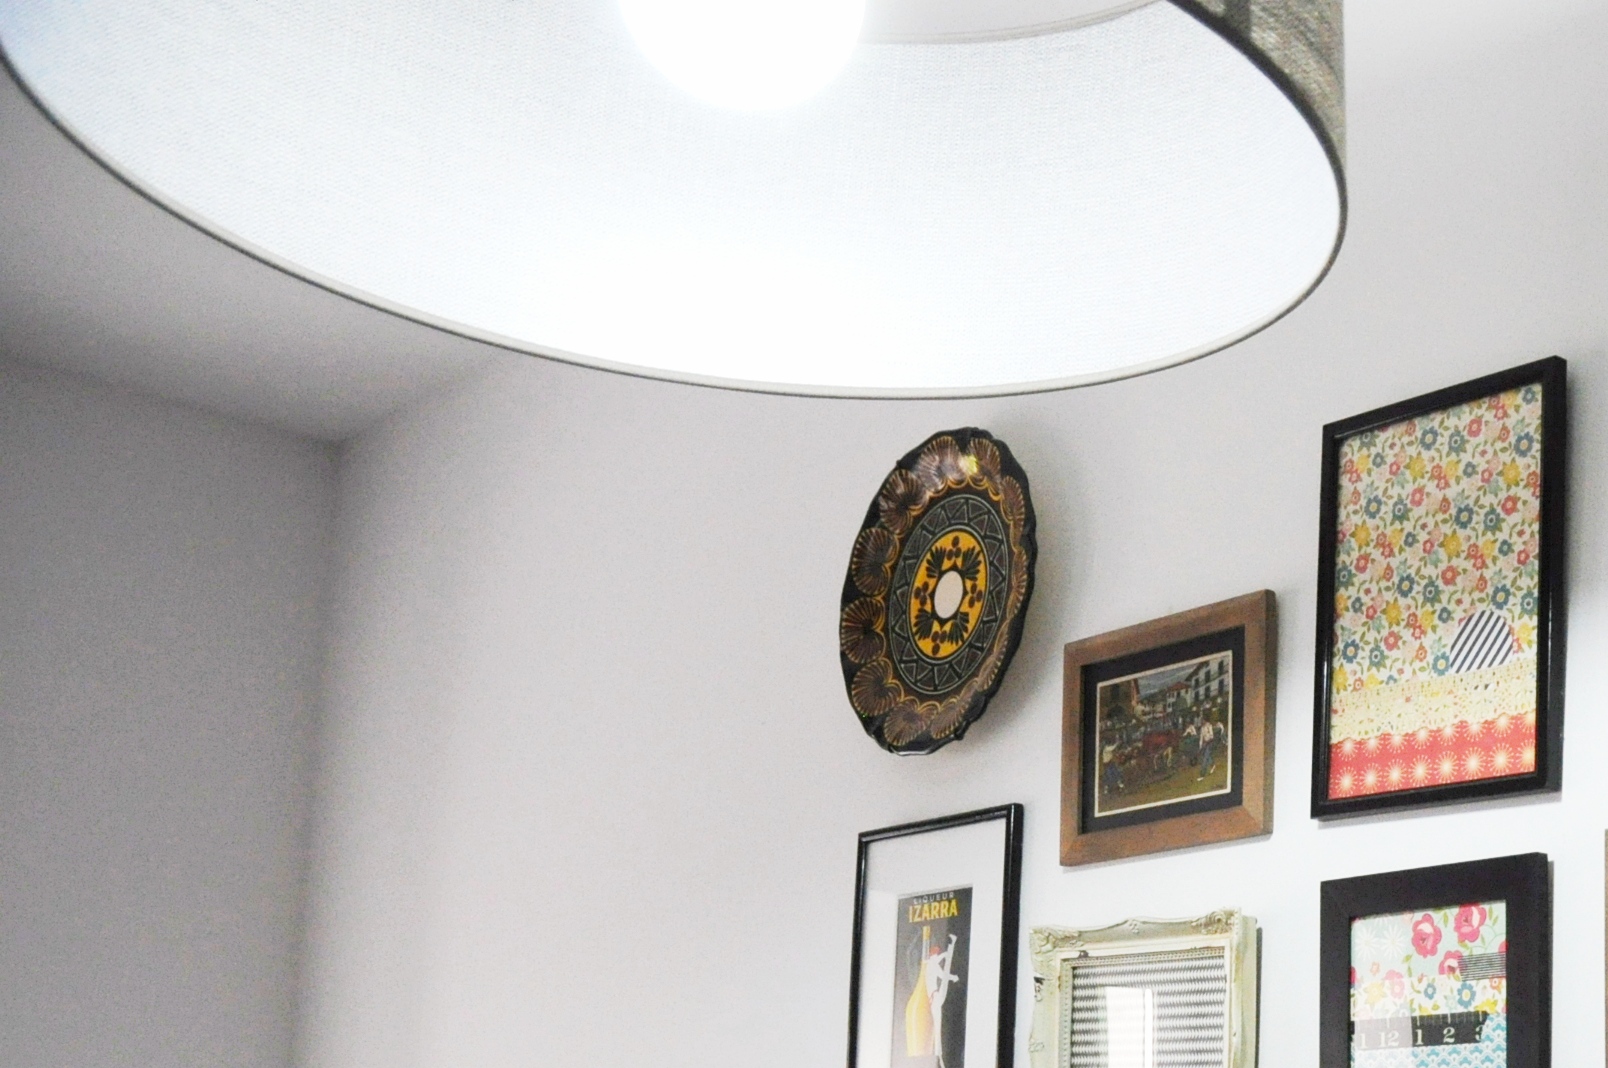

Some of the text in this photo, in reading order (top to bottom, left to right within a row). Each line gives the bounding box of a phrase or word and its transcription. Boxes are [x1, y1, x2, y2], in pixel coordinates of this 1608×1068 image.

[913, 891, 955, 905] LIQUEUR
[909, 899, 959, 923] IZARRA
[1378, 1030, 1400, 1048] 12
[1415, 1029, 1424, 1046] 1
[1443, 1026, 1456, 1043] 2
